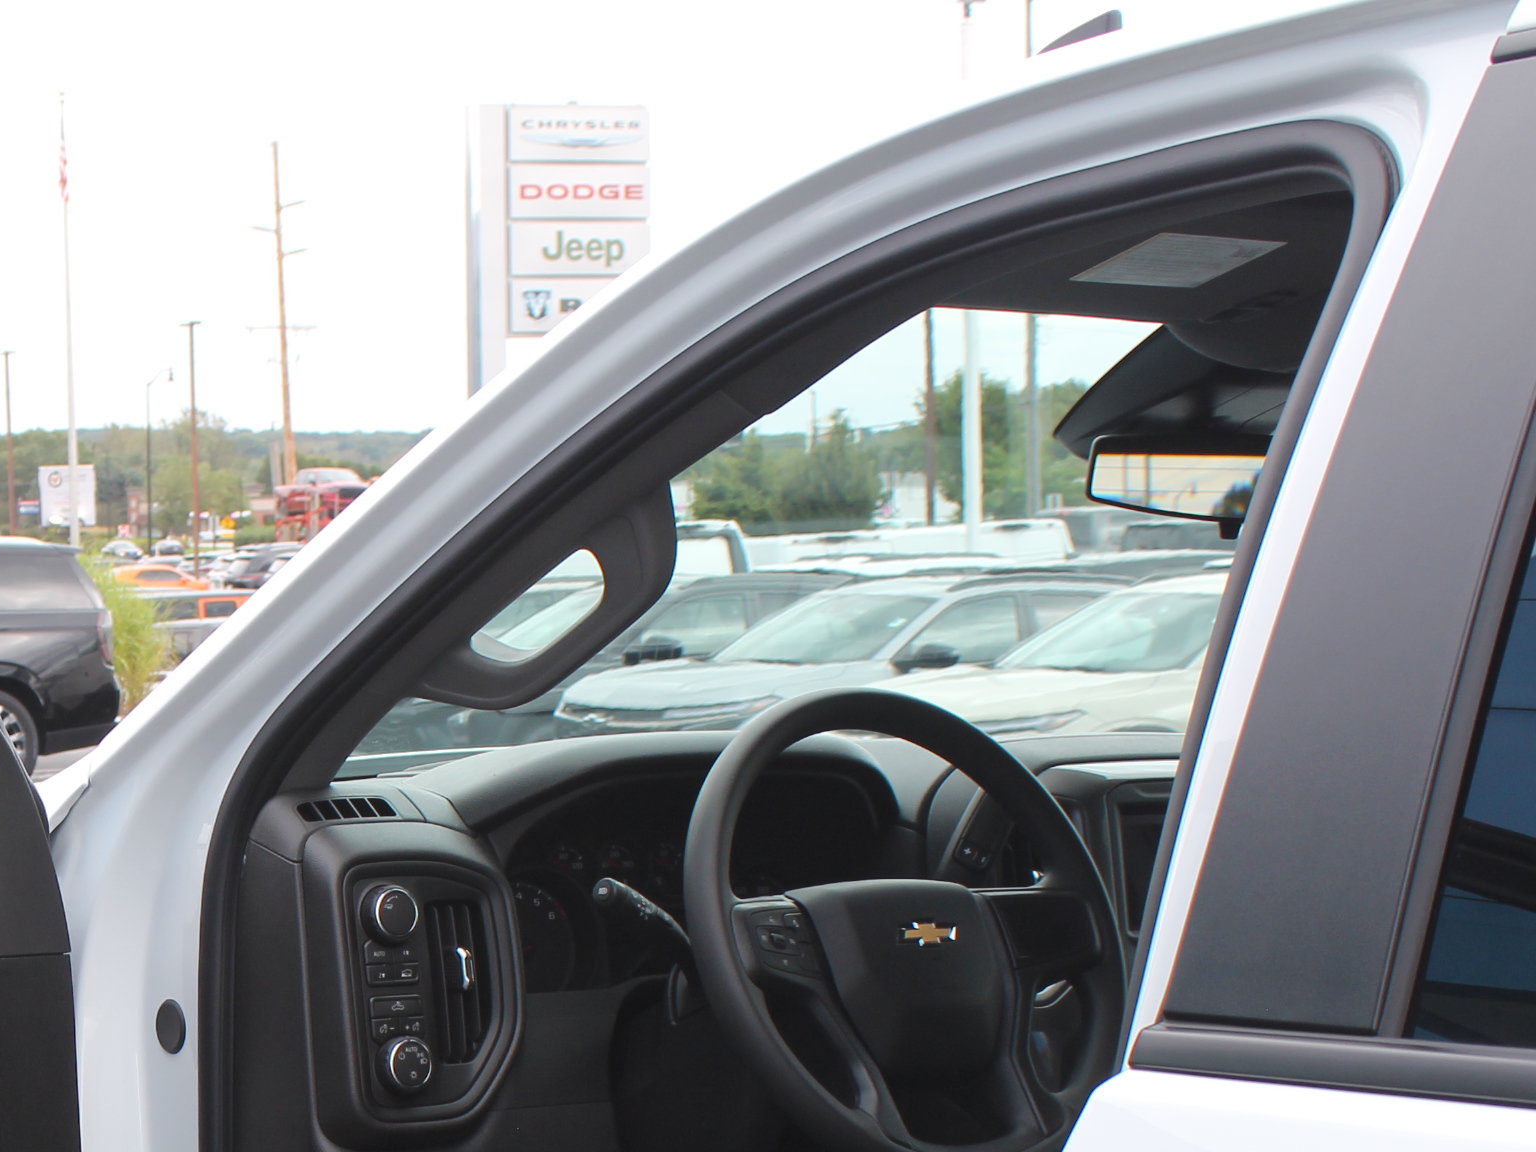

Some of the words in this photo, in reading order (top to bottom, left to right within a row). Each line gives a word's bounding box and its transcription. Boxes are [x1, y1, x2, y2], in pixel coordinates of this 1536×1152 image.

[521, 119, 642, 129] CHRYSLER
[519, 184, 644, 200] DODGE
[542, 230, 626, 267] Jeep
